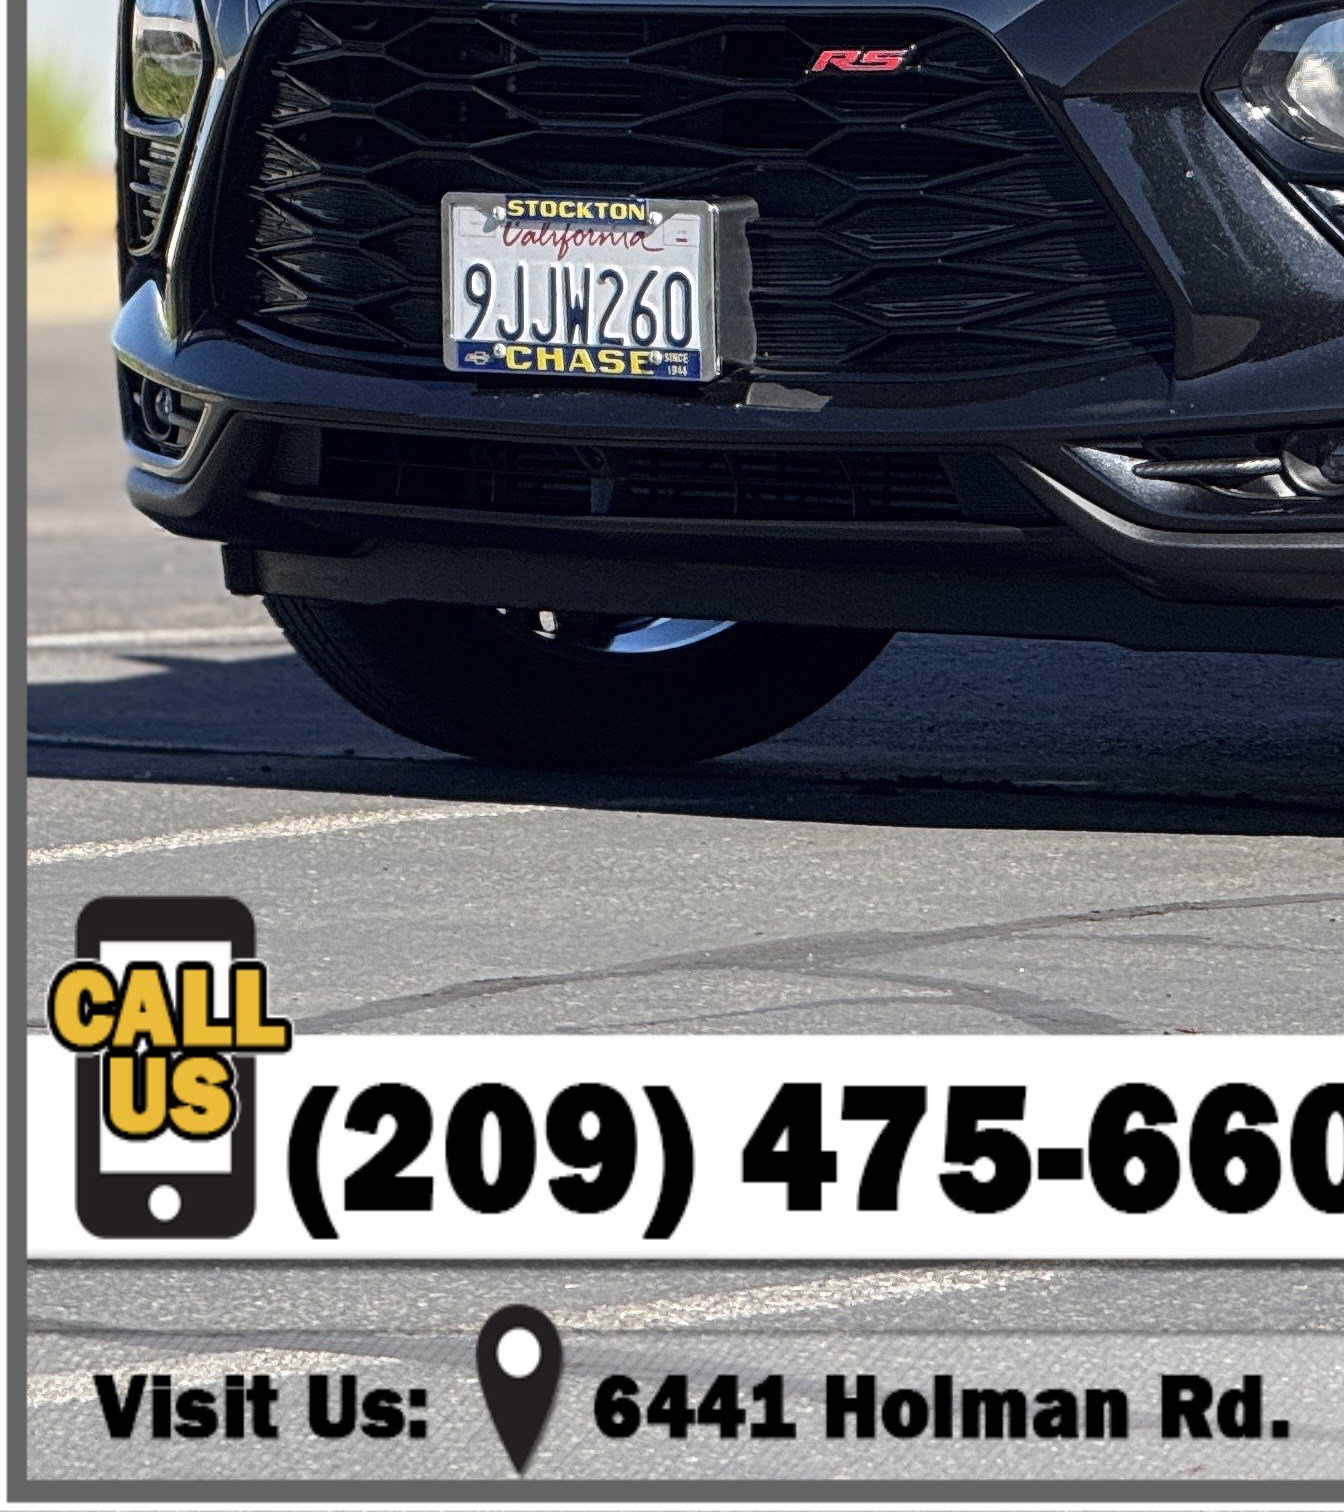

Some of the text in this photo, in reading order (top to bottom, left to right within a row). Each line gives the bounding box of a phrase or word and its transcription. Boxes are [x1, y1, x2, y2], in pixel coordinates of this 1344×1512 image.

[811, 49, 909, 72] RS
[507, 199, 646, 221] STOCKTON
[503, 221, 664, 261] California
[464, 262, 692, 348] 9JJW260
[505, 345, 655, 376] CHASE
